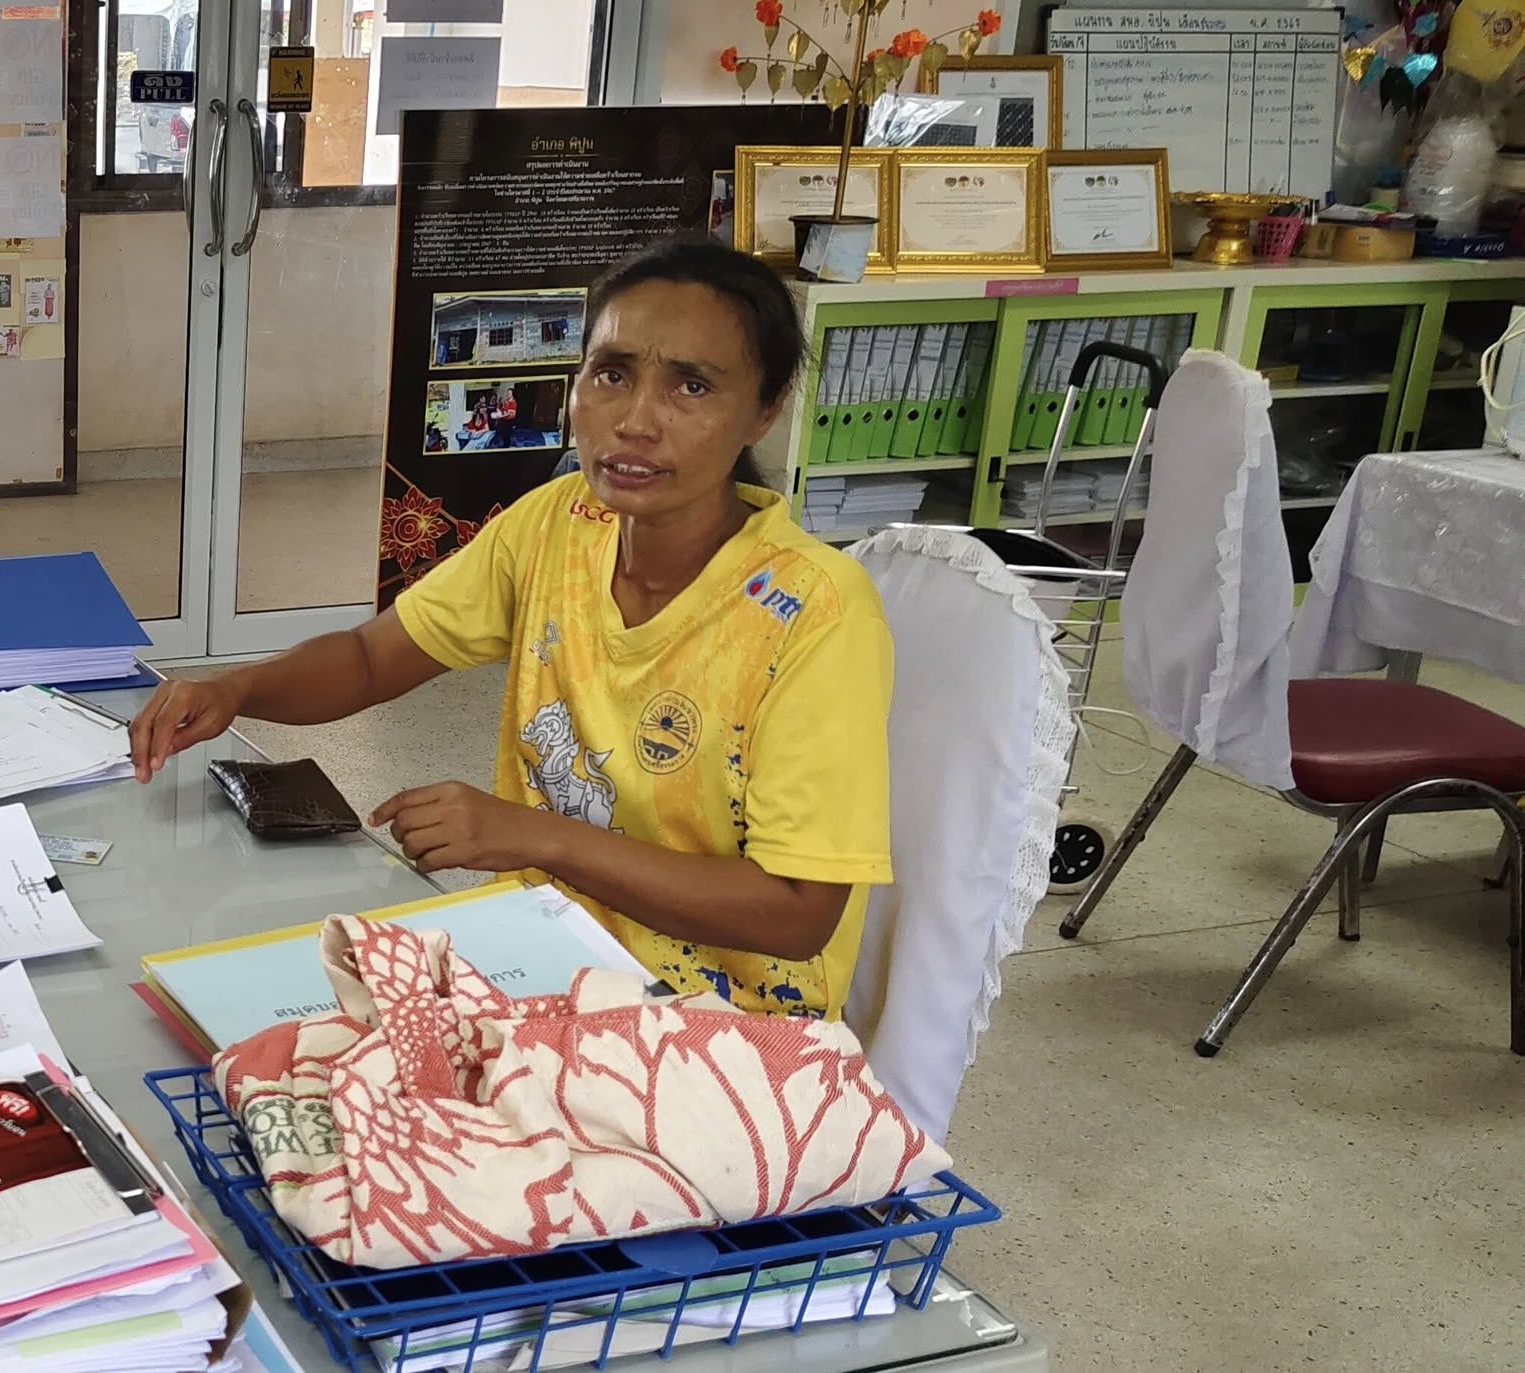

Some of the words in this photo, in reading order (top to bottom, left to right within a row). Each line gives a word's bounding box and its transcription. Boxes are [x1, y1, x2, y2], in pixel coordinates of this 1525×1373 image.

[139, 87, 185, 100] PULL
[531, 137, 564, 151] อำเภอ
[569, 136, 594, 154] พิปูน
